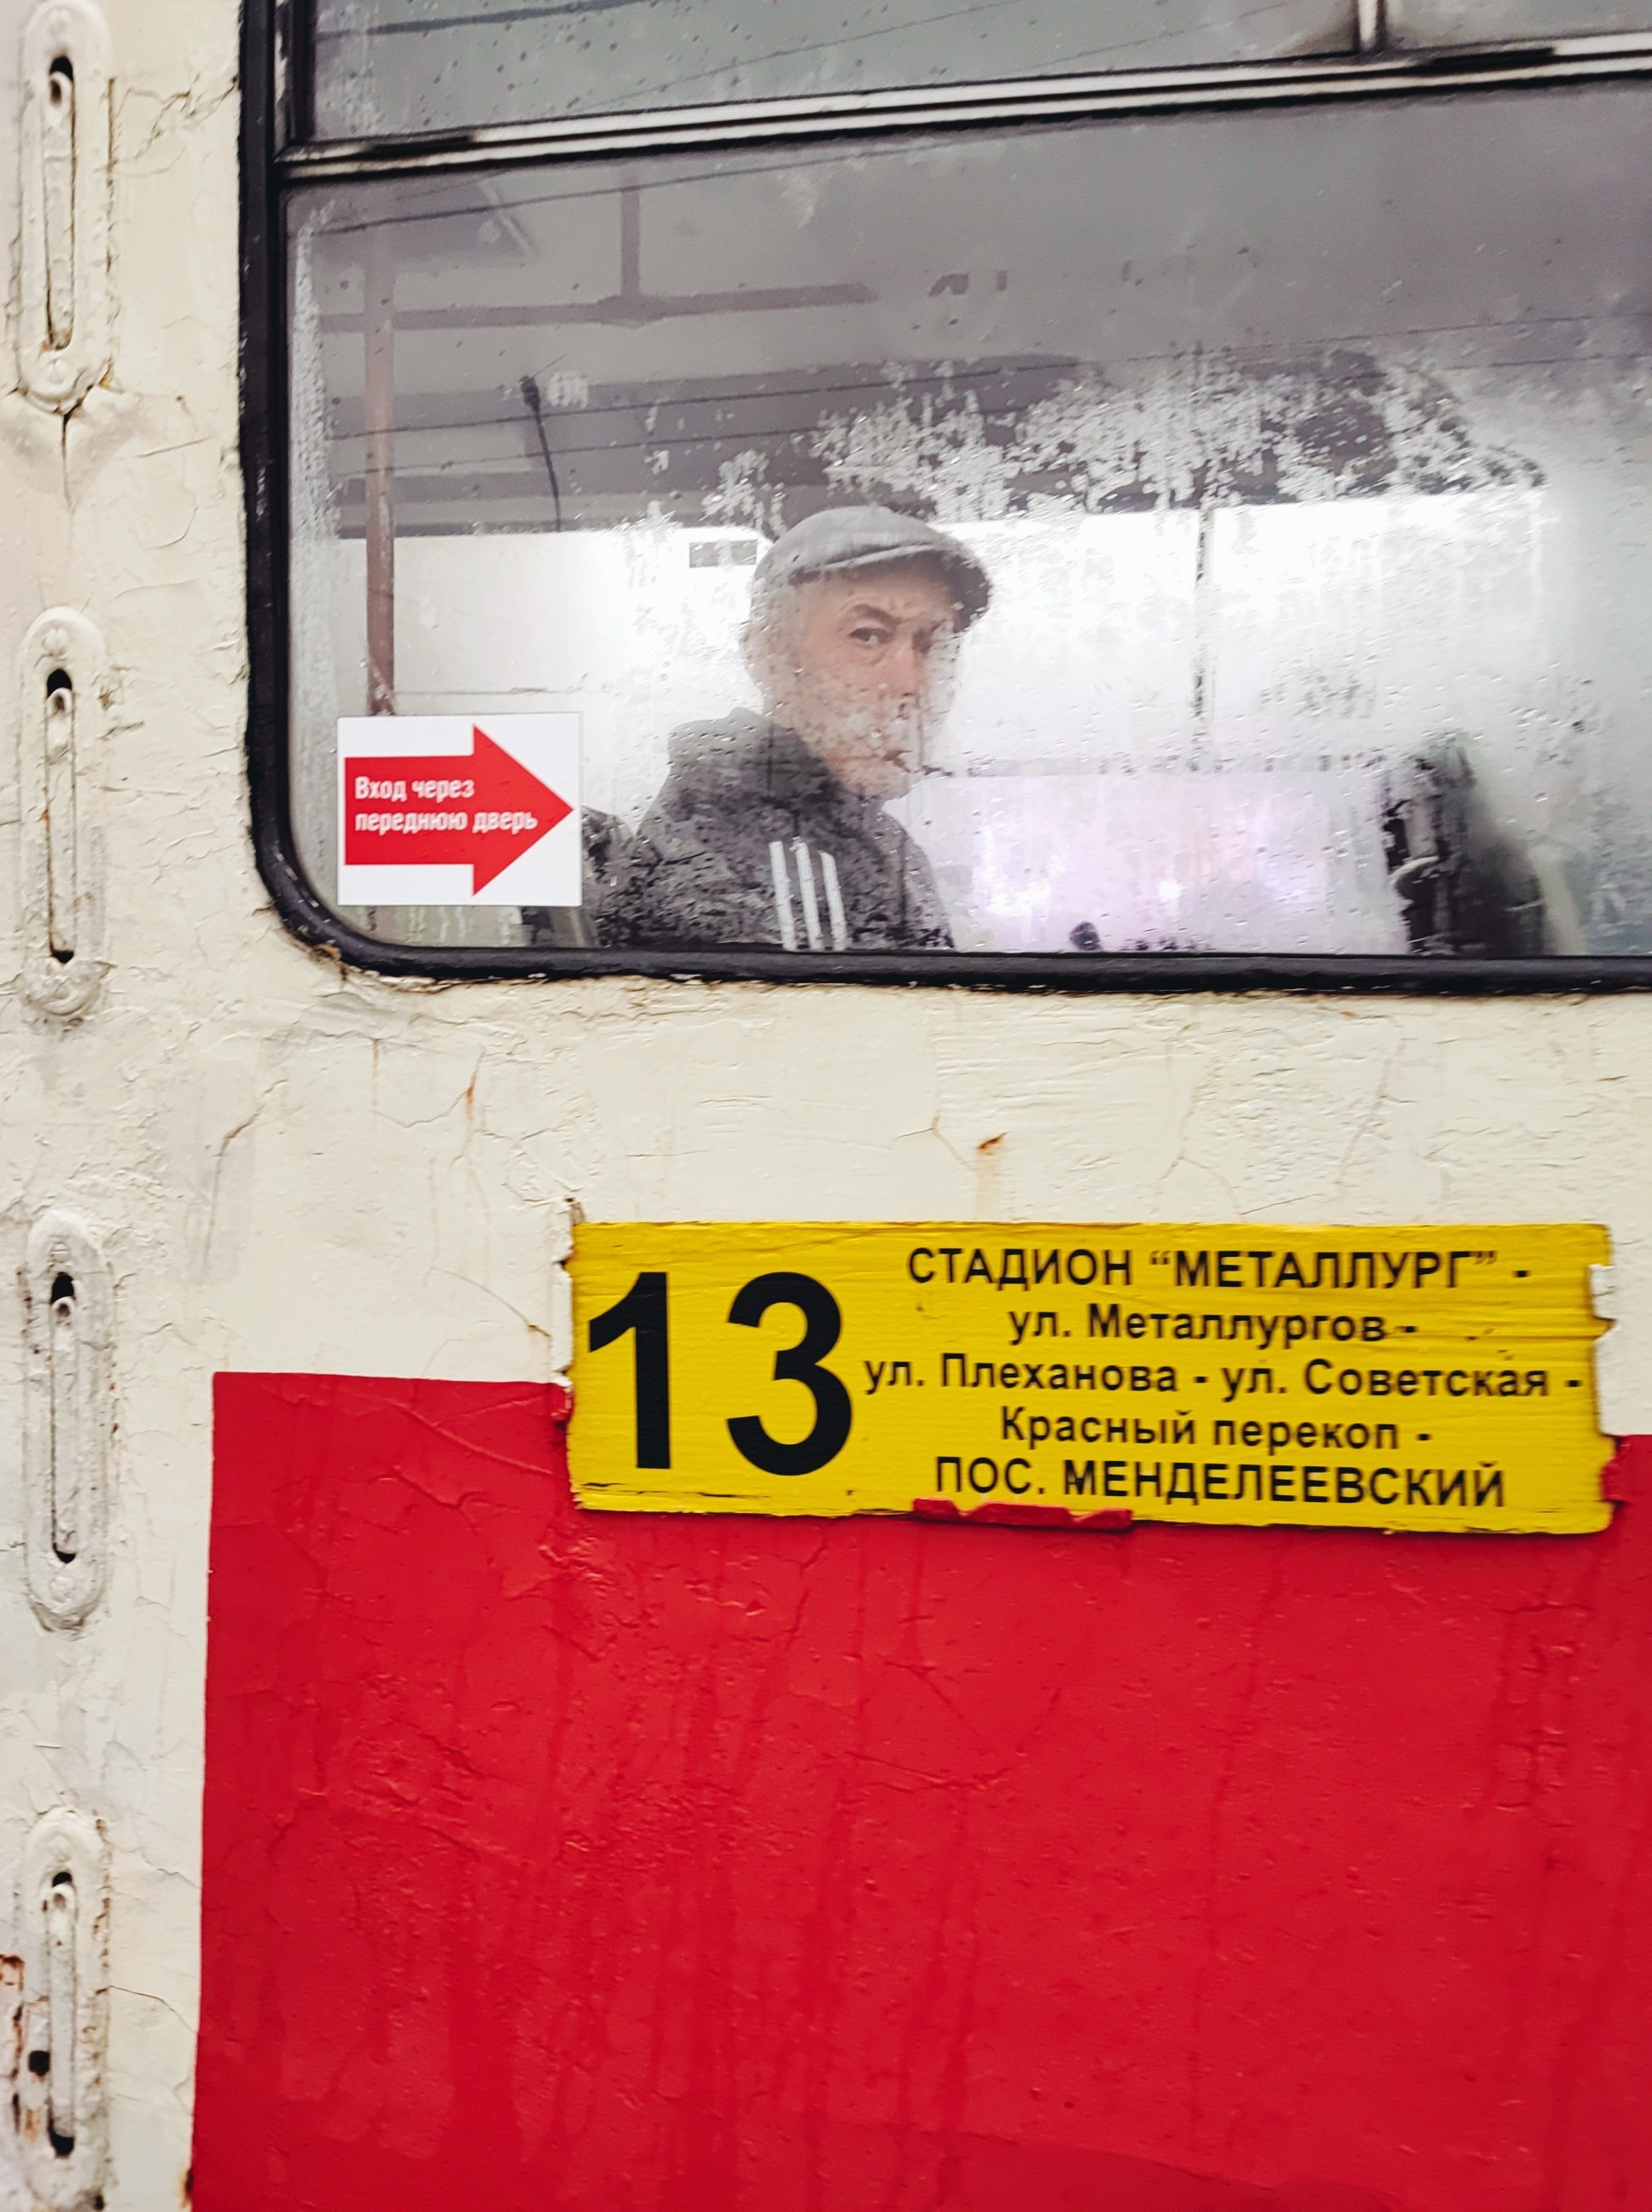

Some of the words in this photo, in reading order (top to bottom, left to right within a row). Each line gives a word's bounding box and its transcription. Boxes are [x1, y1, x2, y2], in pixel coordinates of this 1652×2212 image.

[354, 776, 407, 802] Вход
[411, 779, 475, 803] через
[355, 812, 468, 835] переднюю
[472, 812, 538, 835] дверь
[909, 1246, 1131, 1291] СТАДИОН
[1009, 1309, 1072, 1347] ул.
[1089, 1302, 1387, 1351] Металлургов
[587, 1271, 852, 1477] 13
[864, 1359, 924, 1396] ул.
[941, 1353, 1178, 1392] Плеханова
[1222, 1366, 1287, 1404] ул.
[1305, 1357, 1548, 1398] Советская
[1002, 1406, 1195, 1451] Красный
[1213, 1418, 1399, 1457] перекоп
[936, 1455, 1045, 1495] ПОС.
[1063, 1459, 1505, 1509] МЕНДЕЛЕЕВСКИЙ
